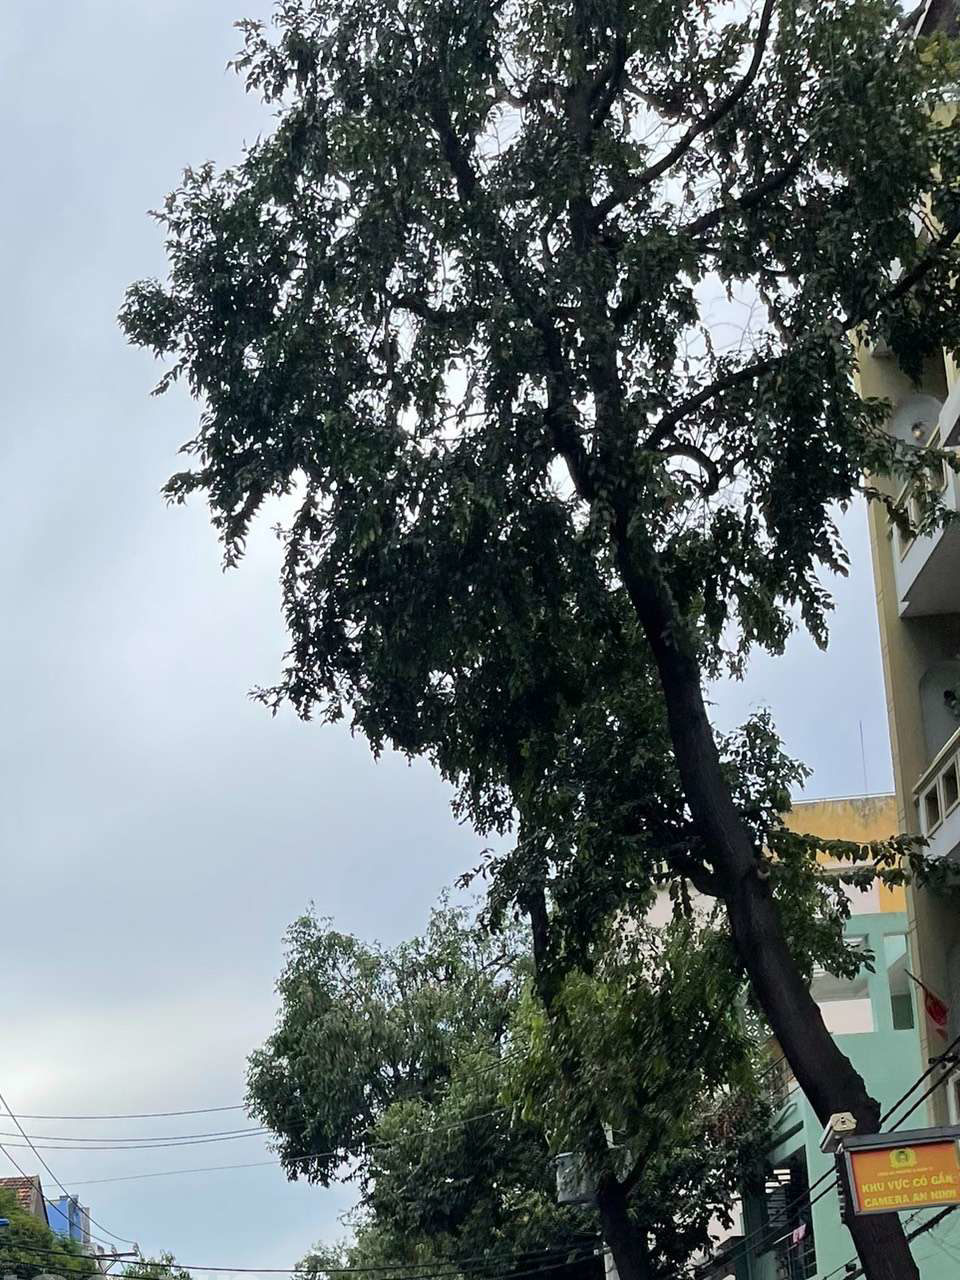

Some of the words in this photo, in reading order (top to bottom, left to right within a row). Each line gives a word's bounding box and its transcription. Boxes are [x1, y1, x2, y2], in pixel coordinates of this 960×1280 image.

[861, 1182, 885, 1193] KHU
[864, 1193, 910, 1208] CAMERA
[912, 1191, 928, 1201] AN
